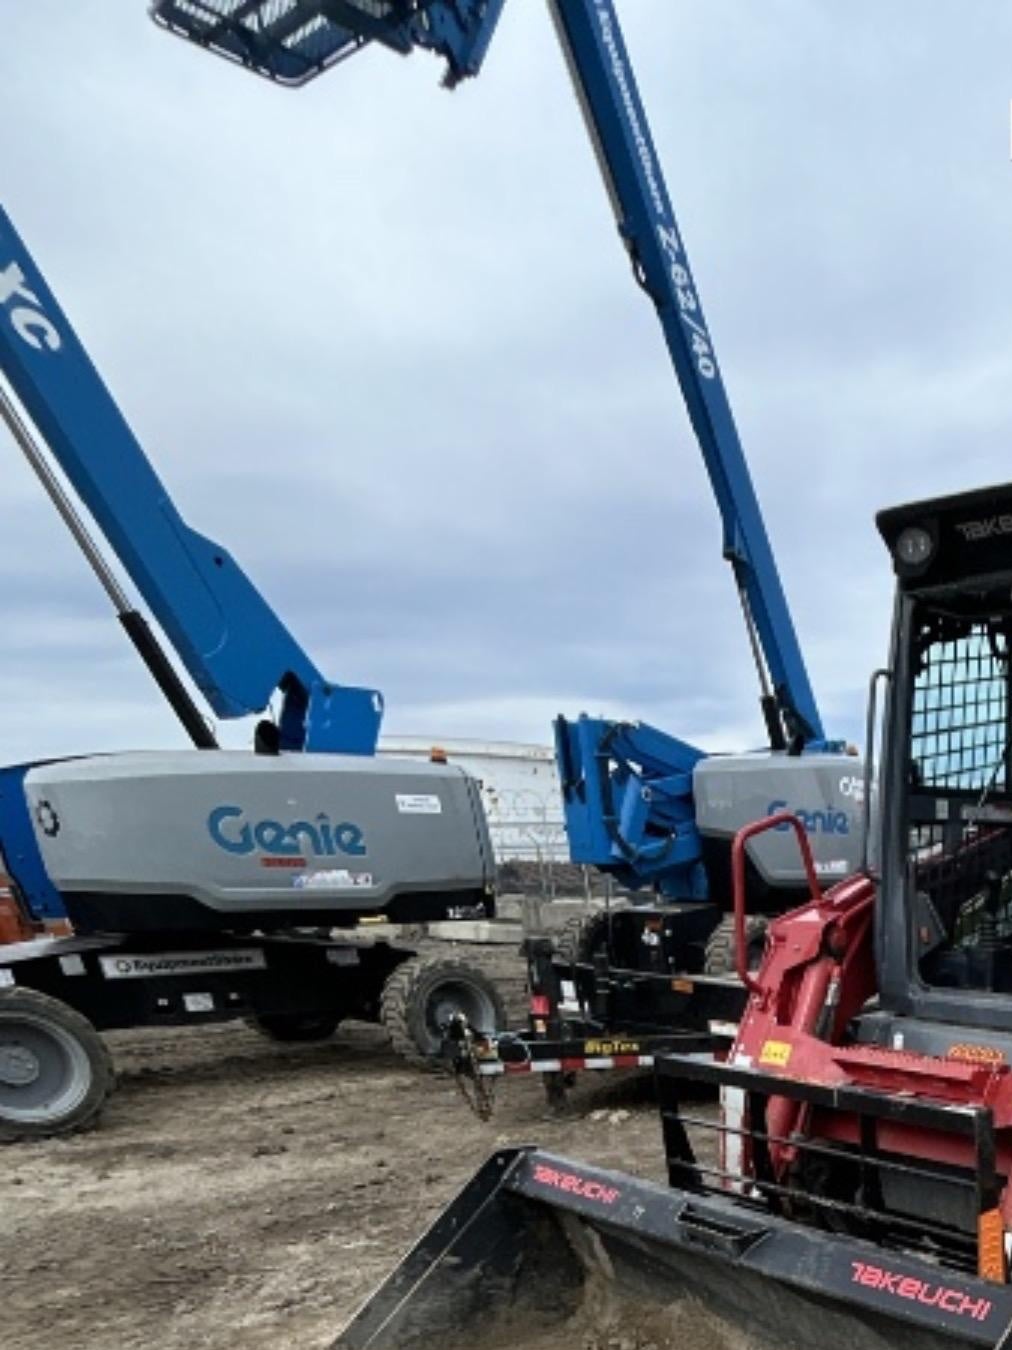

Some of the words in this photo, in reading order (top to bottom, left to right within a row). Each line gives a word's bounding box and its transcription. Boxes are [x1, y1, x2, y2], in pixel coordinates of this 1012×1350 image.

[207, 806, 367, 856] Genie
[531, 1164, 620, 1204] TAKEUCHI
[850, 1261, 992, 1321] TAKEUCHI
